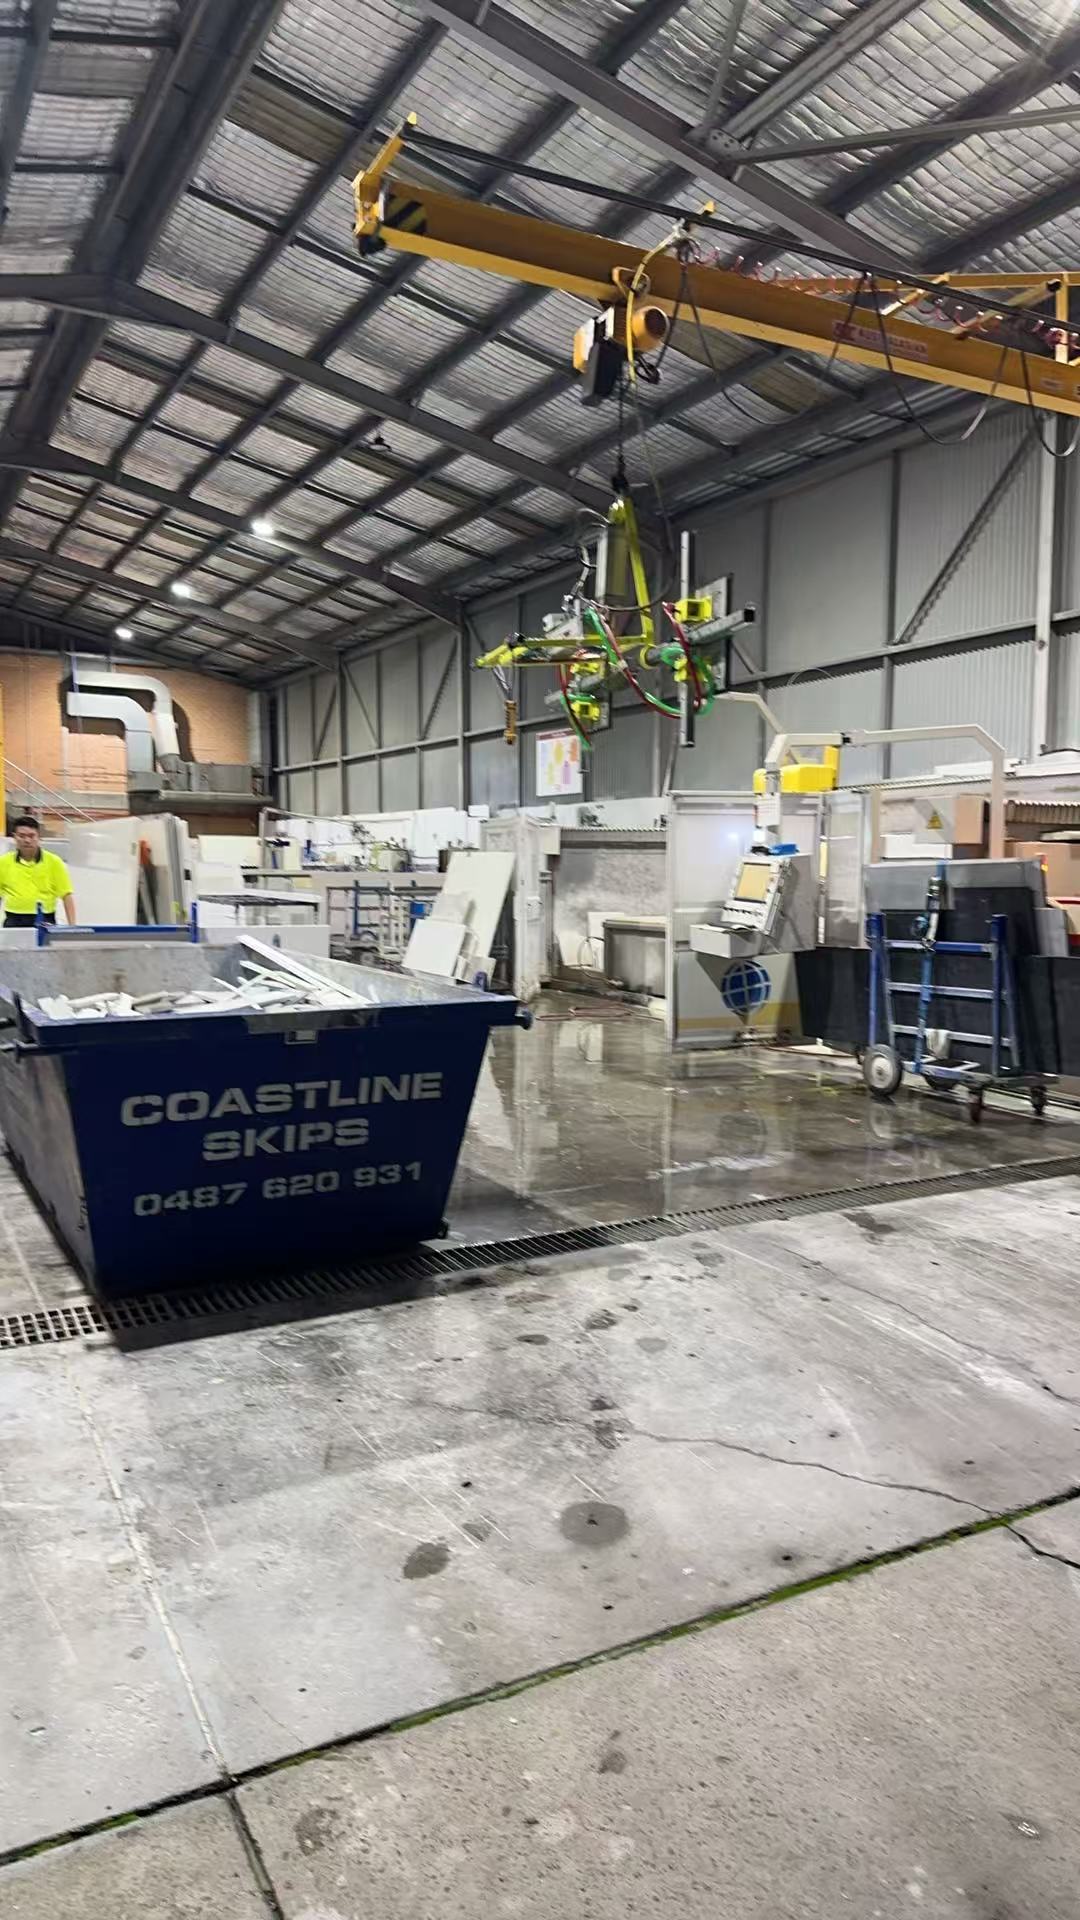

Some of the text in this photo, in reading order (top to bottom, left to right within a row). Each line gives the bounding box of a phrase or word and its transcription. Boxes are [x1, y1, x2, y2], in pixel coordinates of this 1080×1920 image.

[120, 1072, 443, 1126] COASTLINE
[202, 1118, 370, 1161] SKIPS
[133, 1162, 422, 1216] 0487 620 931
